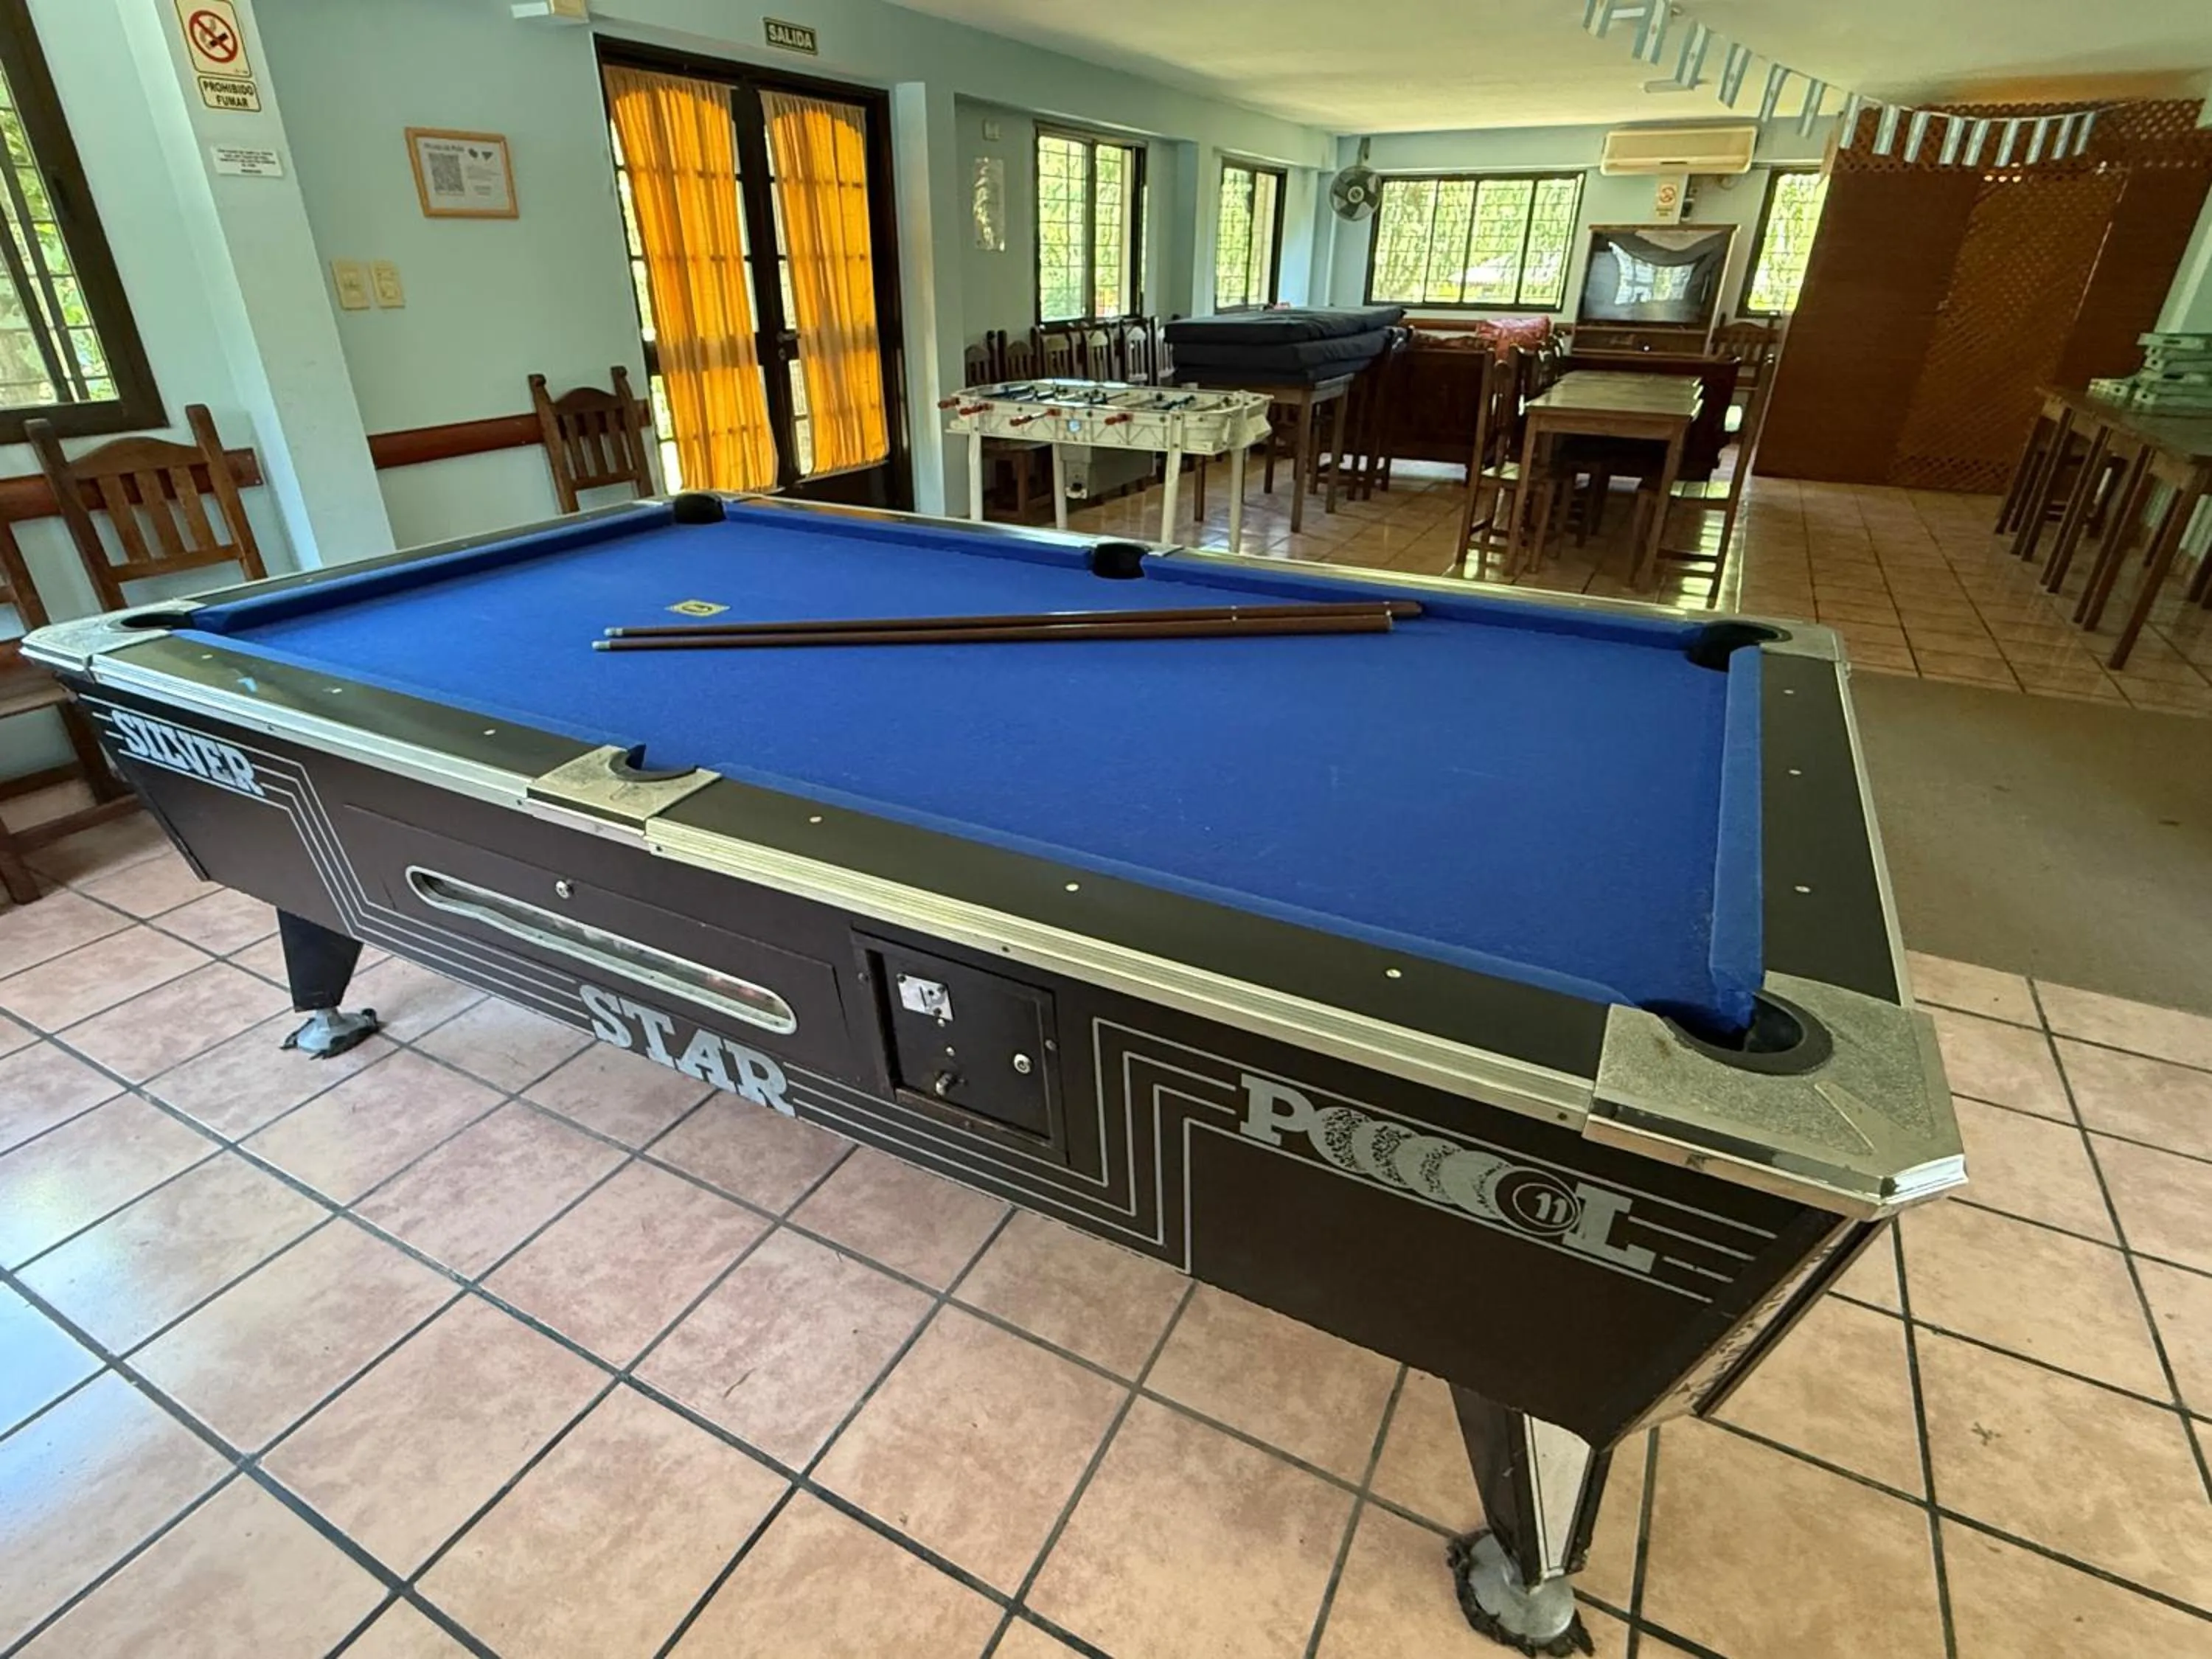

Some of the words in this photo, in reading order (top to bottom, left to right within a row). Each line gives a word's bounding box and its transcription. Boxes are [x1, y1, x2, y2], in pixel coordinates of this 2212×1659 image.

[768, 24, 813, 49] SALIDA
[203, 80, 254, 96] PROHIBIDO
[216, 94, 248, 107] FUMAR
[111, 709, 265, 797] SILVER
[580, 984, 796, 1118] STAR
[1536, 1192, 1568, 1222] 11
